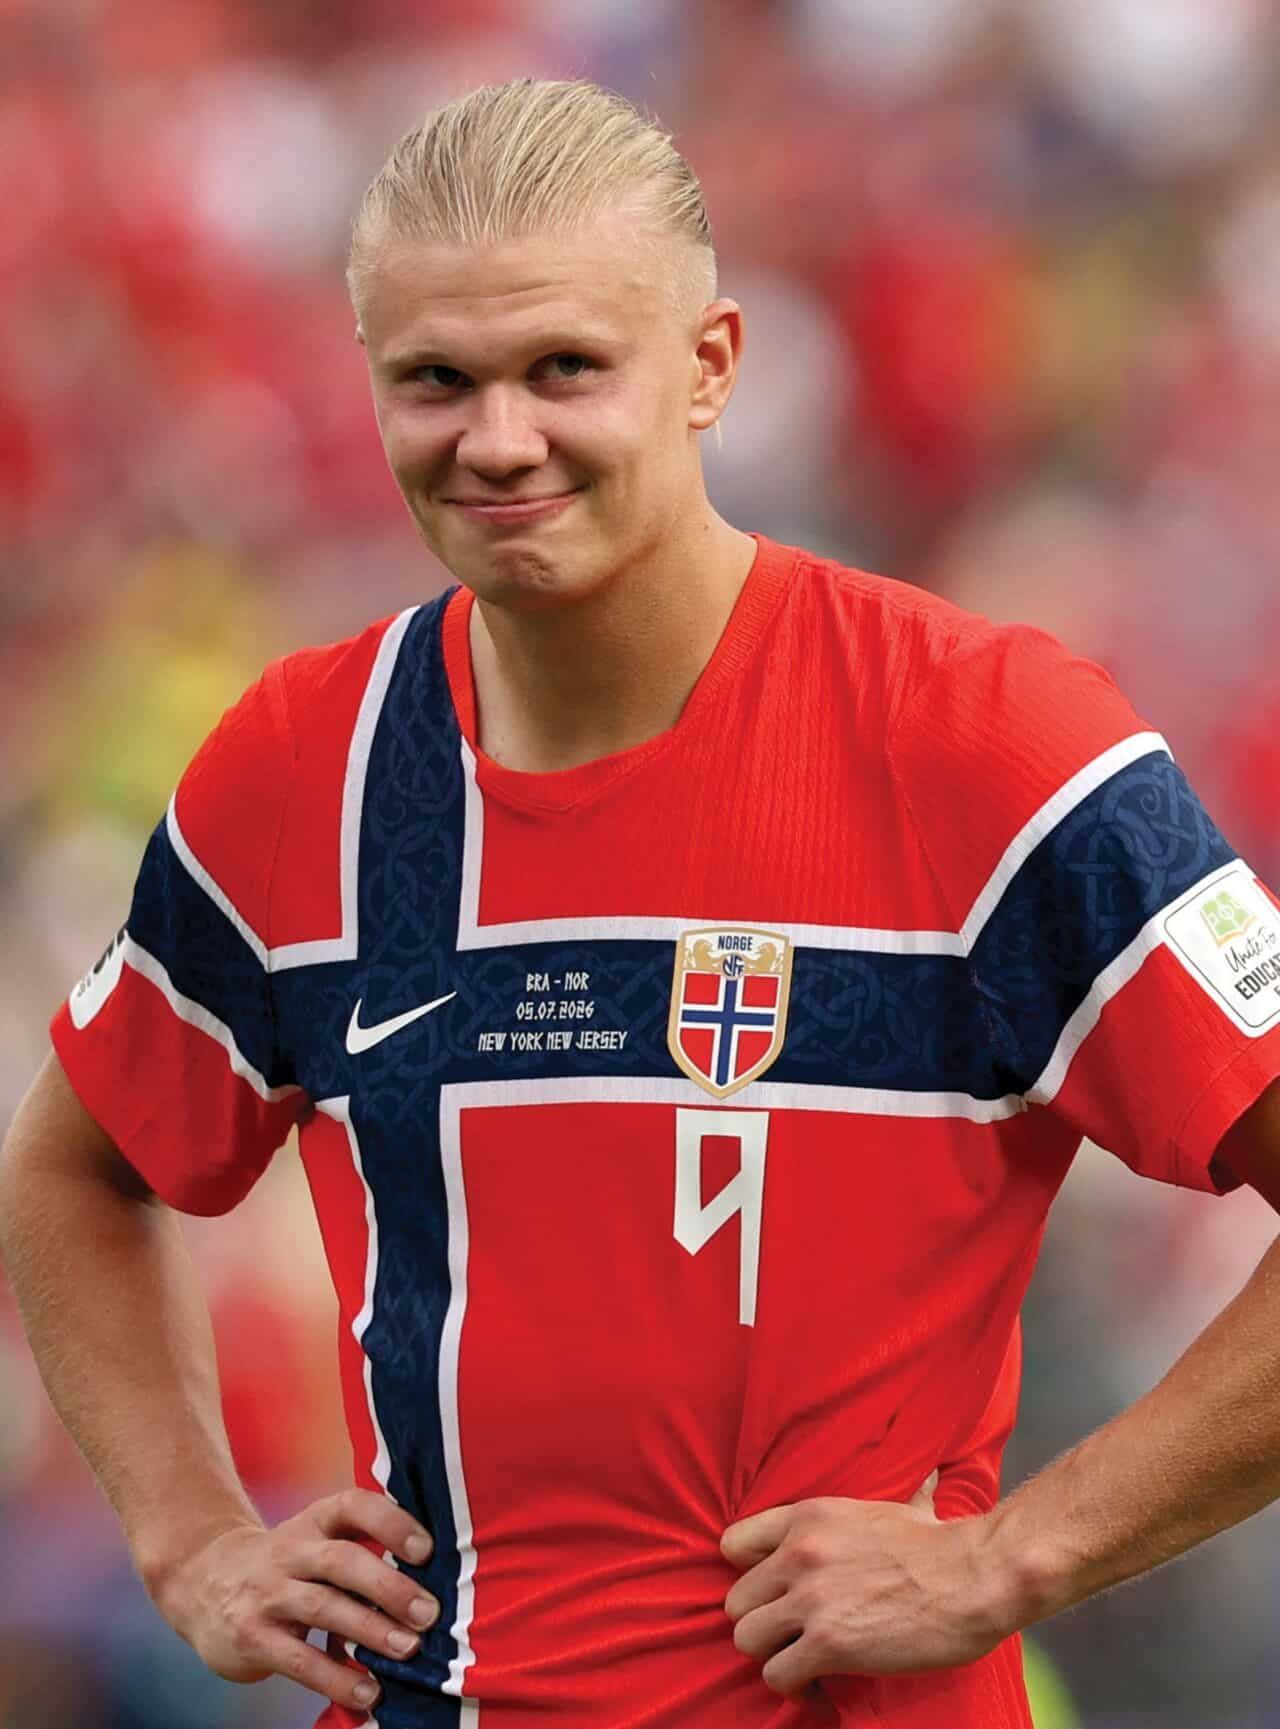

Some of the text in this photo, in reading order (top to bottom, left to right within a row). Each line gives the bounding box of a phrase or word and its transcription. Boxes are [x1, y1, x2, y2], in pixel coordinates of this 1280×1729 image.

[718, 935, 754, 951] NORGE
[1224, 937, 1263, 973] Unite
[526, 973, 550, 992] BRA
[564, 971, 590, 991] NOR
[516, 1000, 595, 1020] 05.07.2026
[478, 1030, 628, 1052] NEW YORK NEW JERSEY
[673, 1106, 770, 1328] 9
